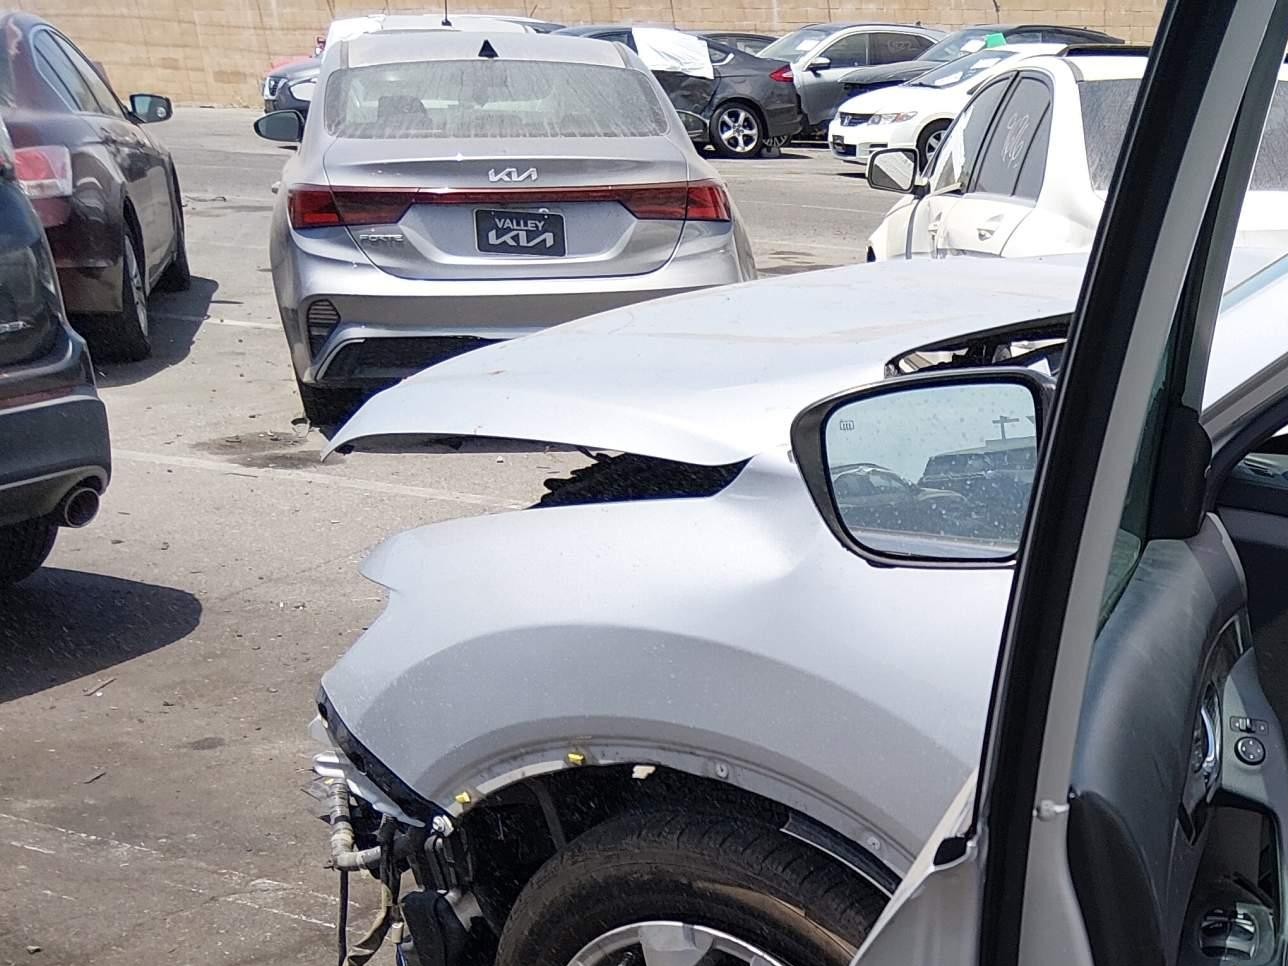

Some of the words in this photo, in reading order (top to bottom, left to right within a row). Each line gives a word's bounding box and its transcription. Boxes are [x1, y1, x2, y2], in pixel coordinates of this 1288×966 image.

[488, 167, 538, 182] KIA
[495, 218, 545, 231] VALLEY
[488, 230, 554, 248] KIA
